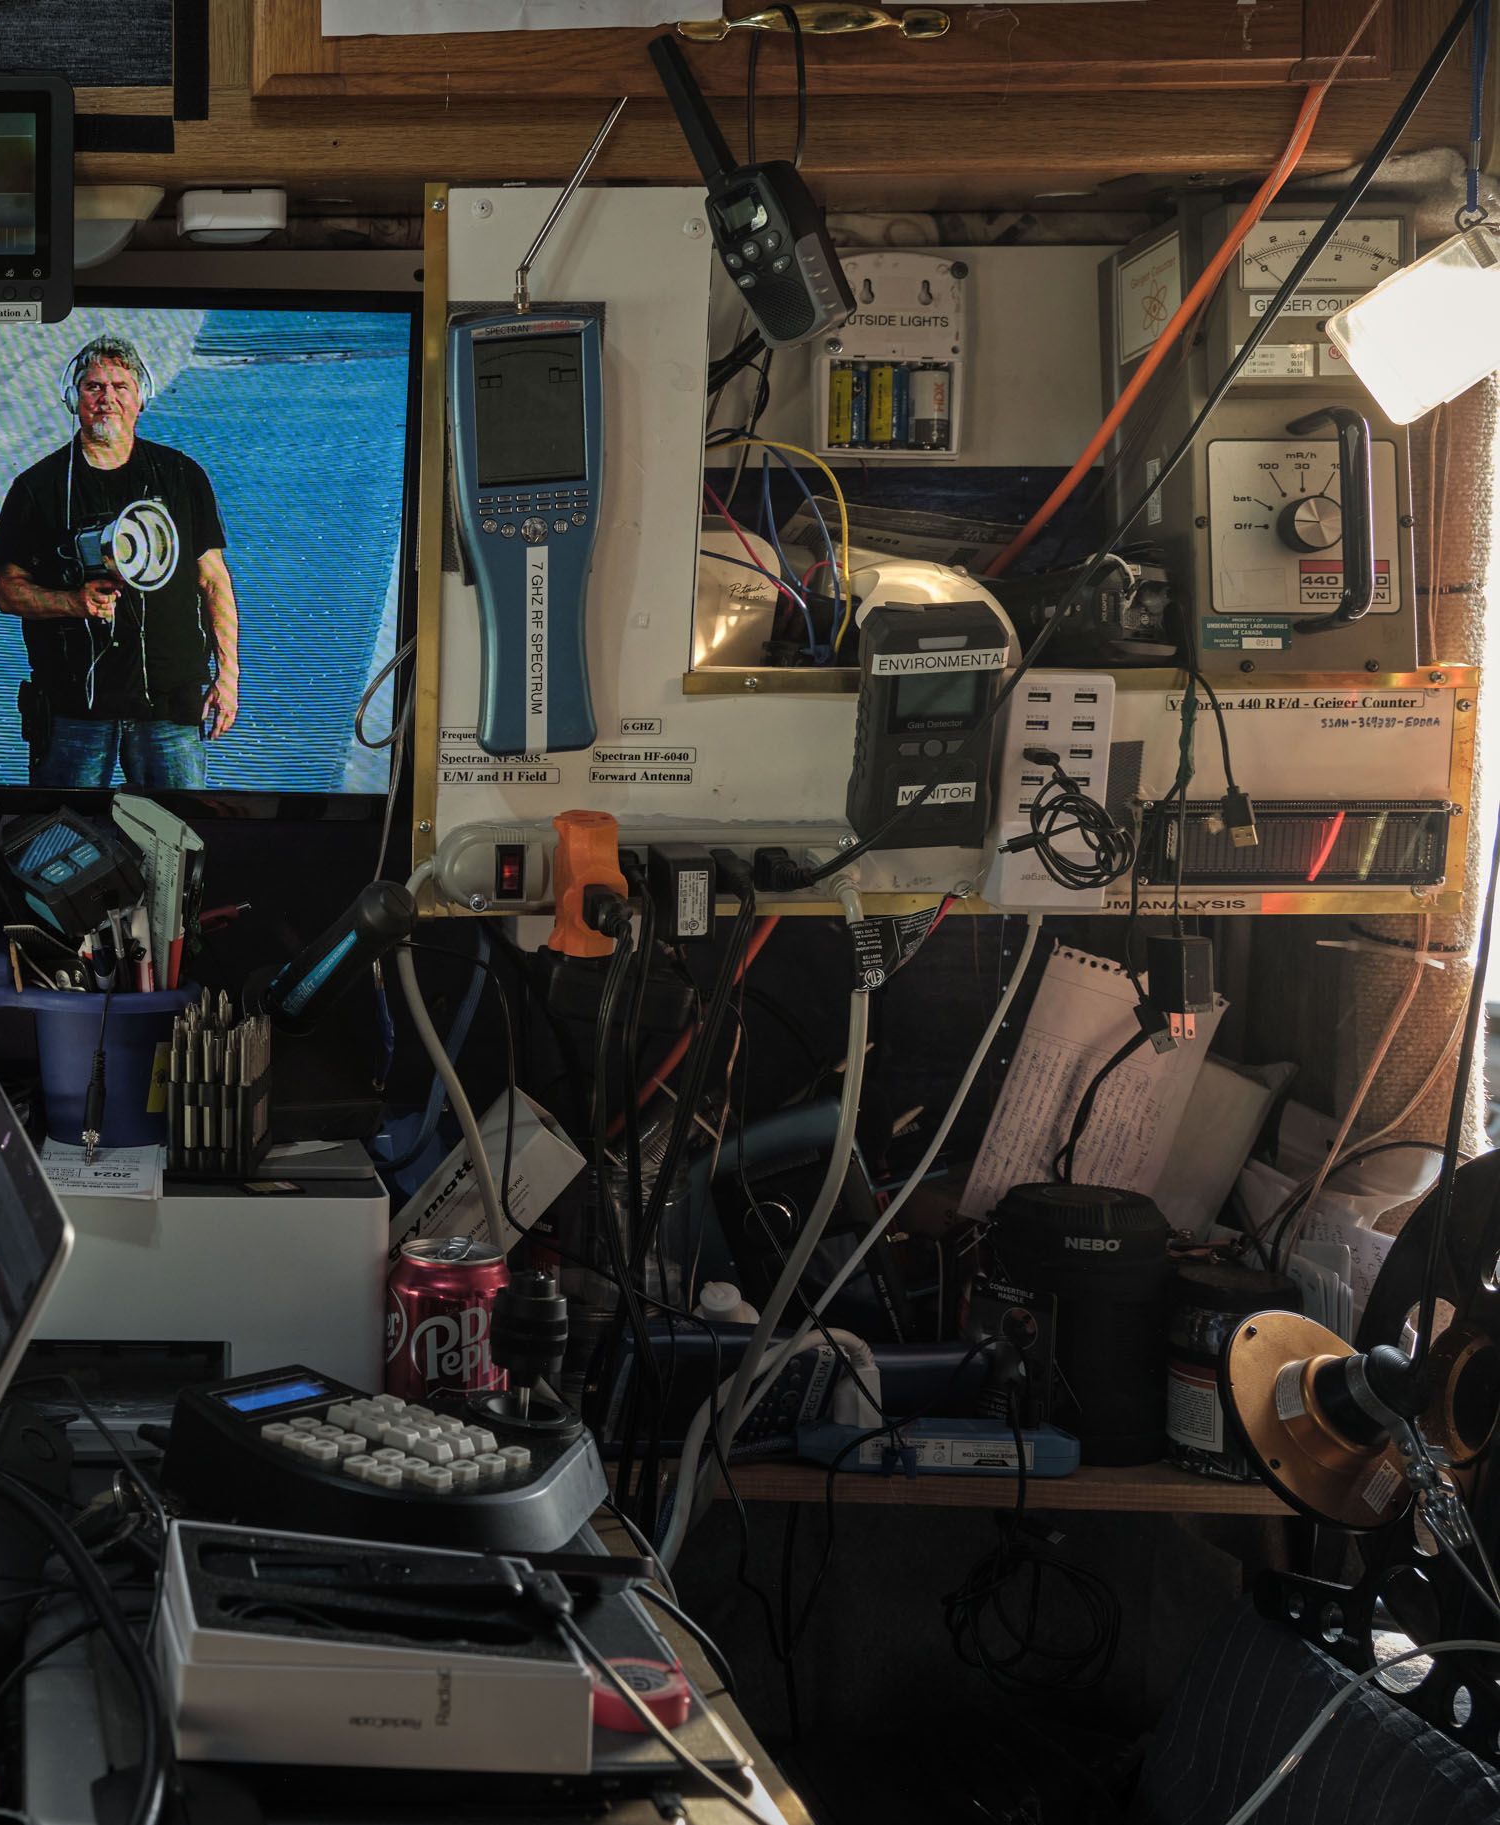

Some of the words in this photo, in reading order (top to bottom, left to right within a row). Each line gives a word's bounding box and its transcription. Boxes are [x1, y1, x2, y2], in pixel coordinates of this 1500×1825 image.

[23, 309, 31, 317] A
[845, 314, 897, 326] UTSIDE
[900, 316, 949, 327] LIGHTS
[485, 325, 529, 336] SPECTRAN
[933, 382, 945, 413] HDX
[531, 562, 544, 570] 7
[1301, 576, 1338, 585] 440
[531, 574, 544, 605] GHZ
[531, 610, 544, 629] RF
[1256, 639, 1274, 647] 0911
[879, 653, 1007, 671] ENVIRONMENTAL
[531, 633, 543, 715] SPECTRUM
[1238, 699, 1261, 709] 440
[1314, 697, 1358, 709] Geiger
[1362, 697, 1417, 708] Counter
[623, 723, 629, 731] 6
[631, 722, 654, 731] GHZ
[907, 720, 924, 729] Gas
[927, 719, 963, 728] Detector
[441, 753, 489, 765] Spectran
[595, 751, 641, 762] Spectran
[644, 751, 689, 761] HF-6040
[477, 771, 500, 782] and
[503, 771, 514, 782] H
[517, 771, 547, 782] Field
[592, 772, 637, 782] Forward
[640, 770, 691, 782] Antenna
[1141, 900, 1246, 910] ANALYSIS
[1064, 1236, 1120, 1252] NEBO
[989, 1282, 1035, 1300] CONVERTIBLE
[998, 1292, 1024, 1304] HANDLE
